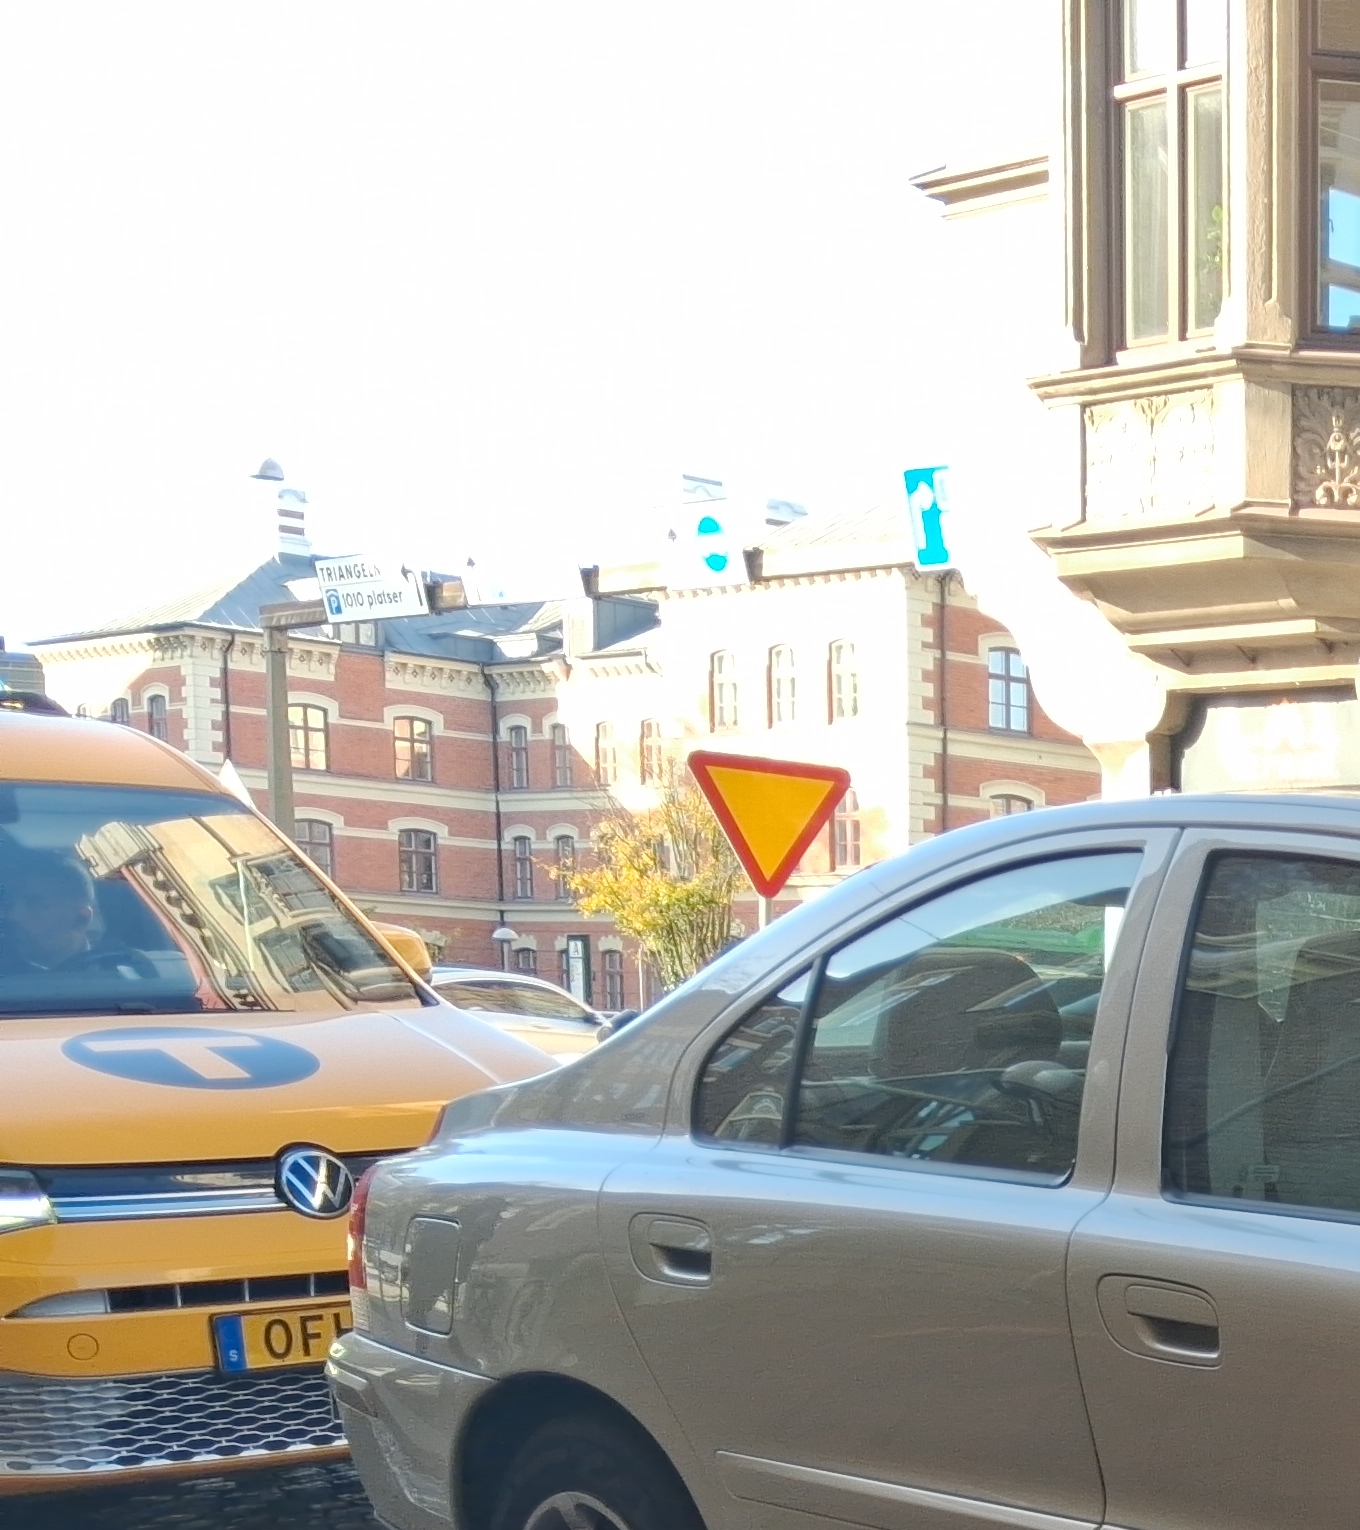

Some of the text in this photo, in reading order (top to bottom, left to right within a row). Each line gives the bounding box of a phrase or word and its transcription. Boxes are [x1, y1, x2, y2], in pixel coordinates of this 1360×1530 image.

[342, 591, 364, 608] 1010
[367, 589, 403, 610] platser
[229, 1349, 238, 1362] S
